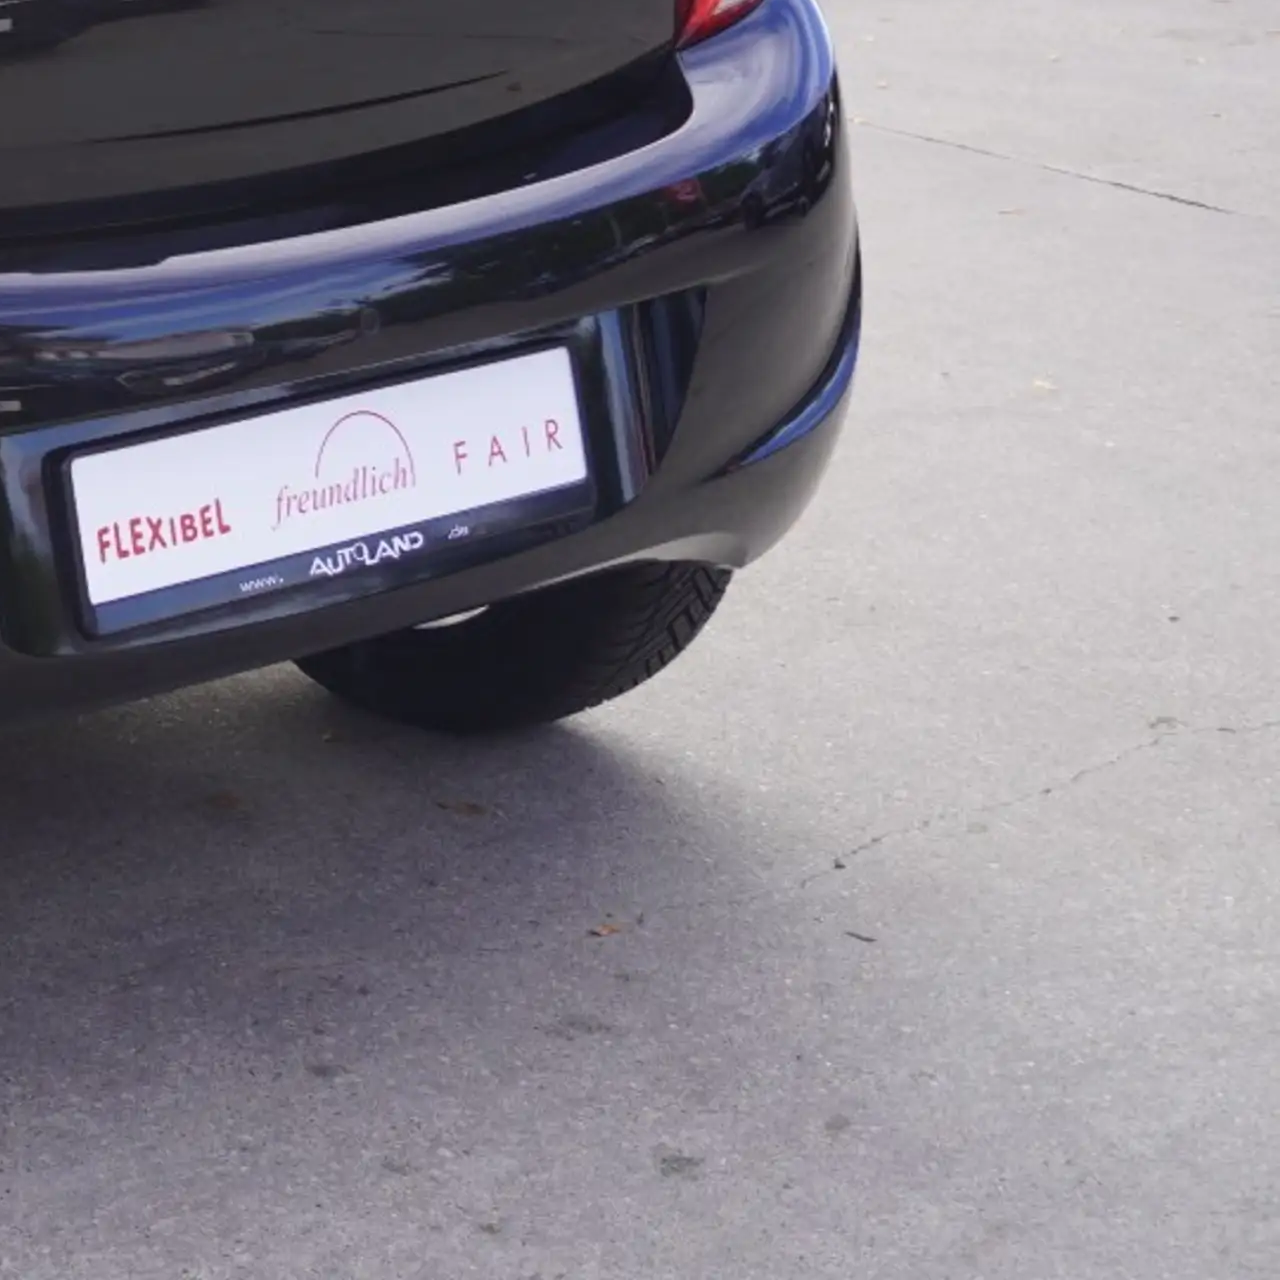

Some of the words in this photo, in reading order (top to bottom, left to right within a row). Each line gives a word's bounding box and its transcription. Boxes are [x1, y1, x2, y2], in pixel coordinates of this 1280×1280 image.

[96, 497, 232, 564] FLEXIBEL
[272, 456, 409, 533] freundlich
[453, 418, 564, 476] FAIR
